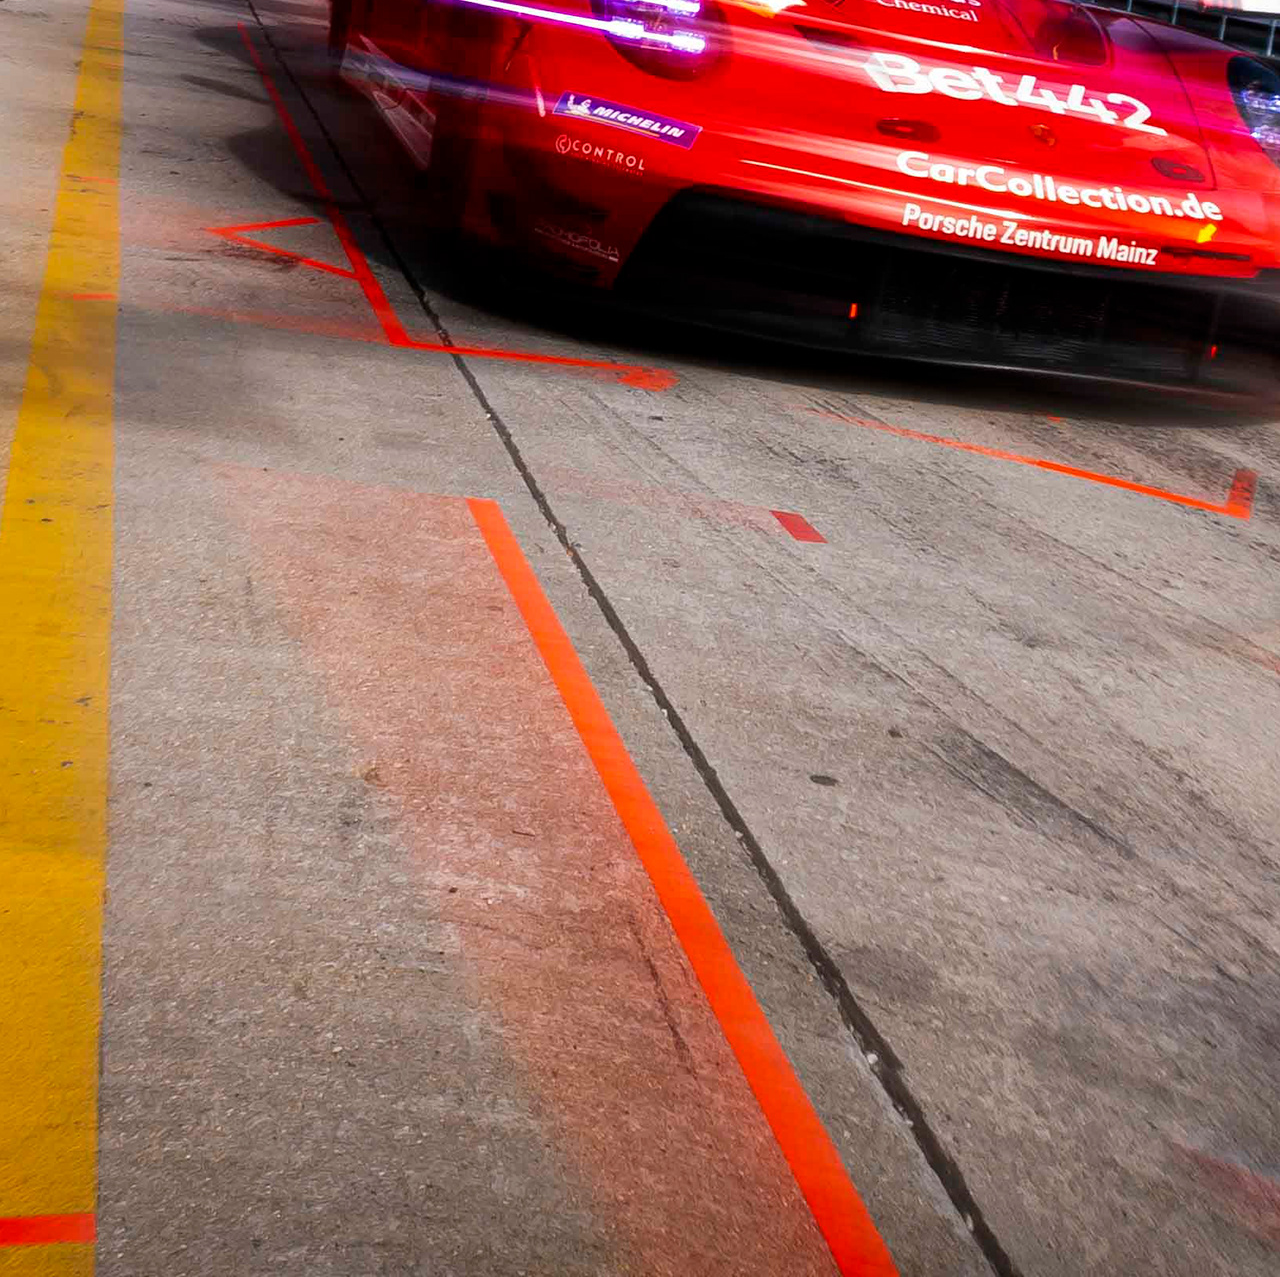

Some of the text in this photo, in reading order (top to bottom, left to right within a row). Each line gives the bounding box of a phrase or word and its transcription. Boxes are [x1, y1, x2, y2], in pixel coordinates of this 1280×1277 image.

[592, 106, 686, 139] MICHELIN
[863, 52, 1168, 136] Bet442
[572, 140, 646, 171] CONTROL
[896, 150, 1224, 221] CarCollection.de
[901, 202, 1159, 266] Porsche Zentrum Mainz
